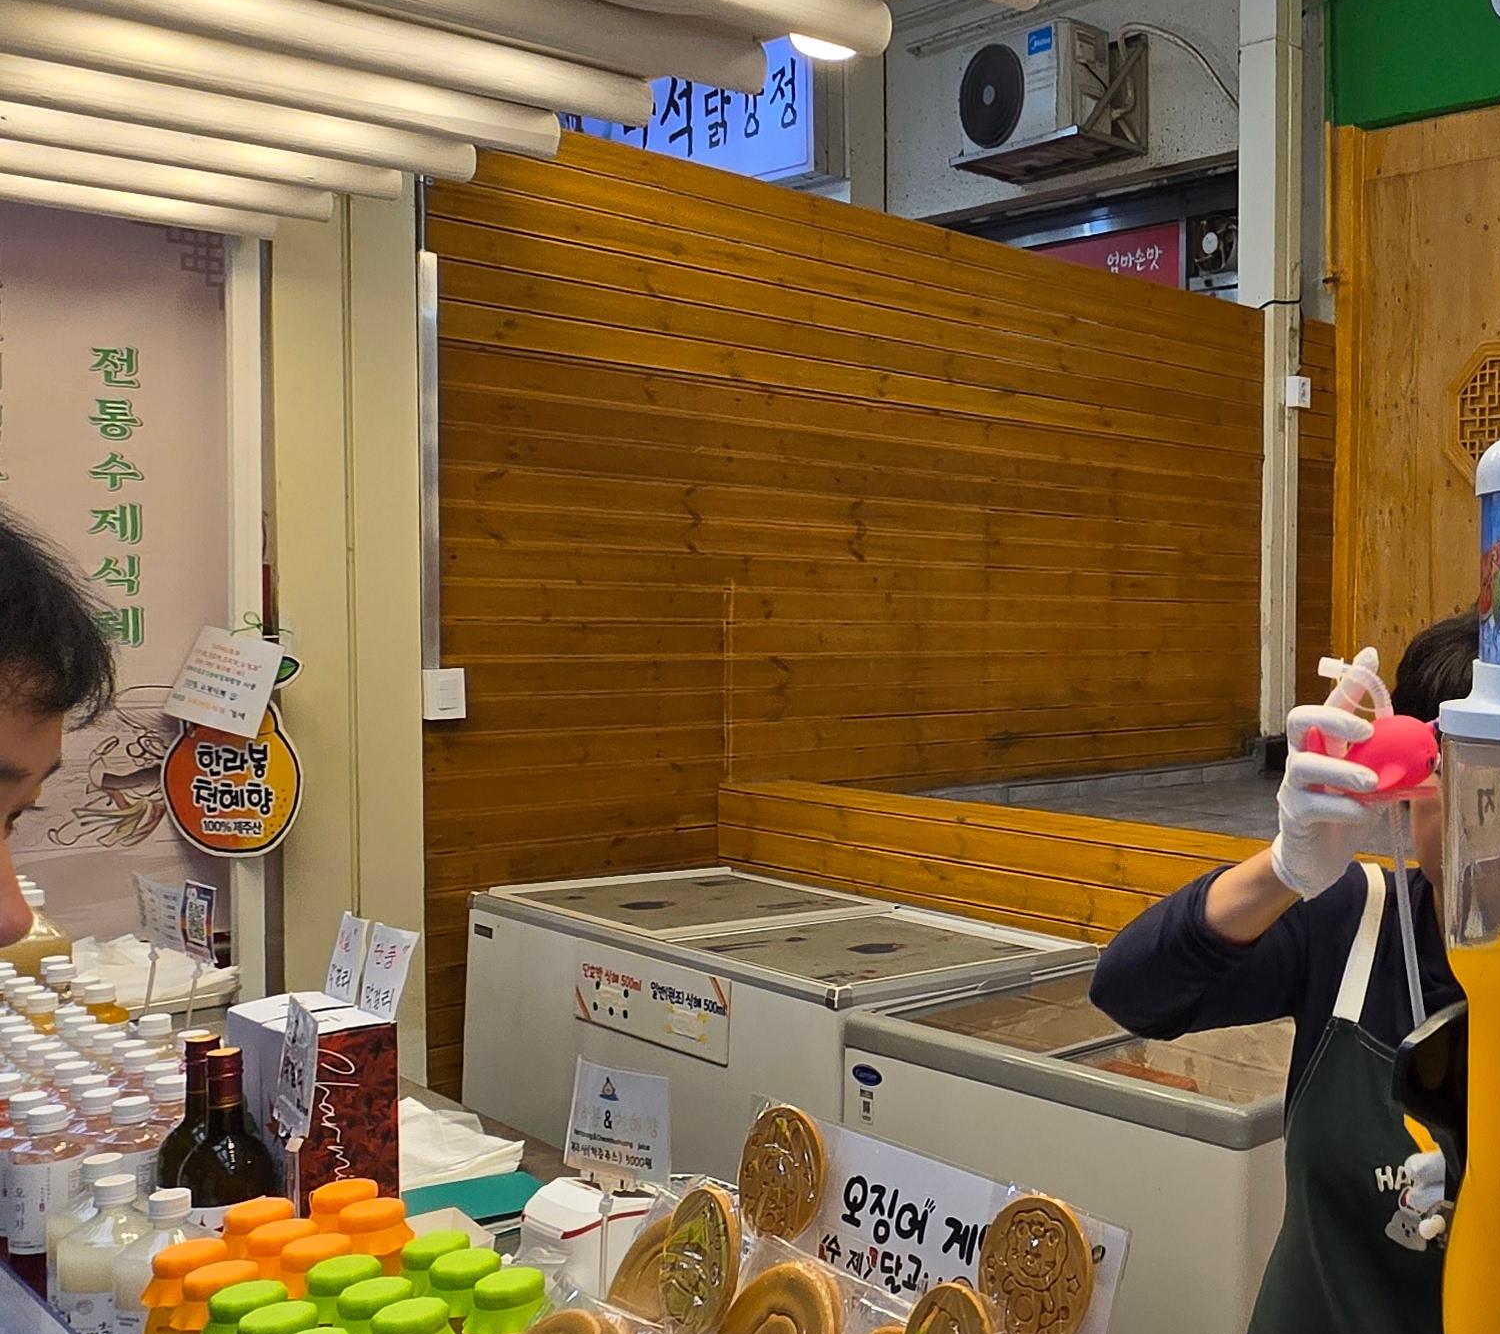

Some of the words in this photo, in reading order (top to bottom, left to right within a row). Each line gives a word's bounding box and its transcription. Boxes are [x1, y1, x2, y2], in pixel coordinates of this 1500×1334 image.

[196, 742, 268, 779] 한라봉
[192, 778, 273, 815] 천혜향
[203, 820, 232, 833] 100%
[233, 820, 263, 835] 제주산
[841, 1175, 931, 1245] 오징어
